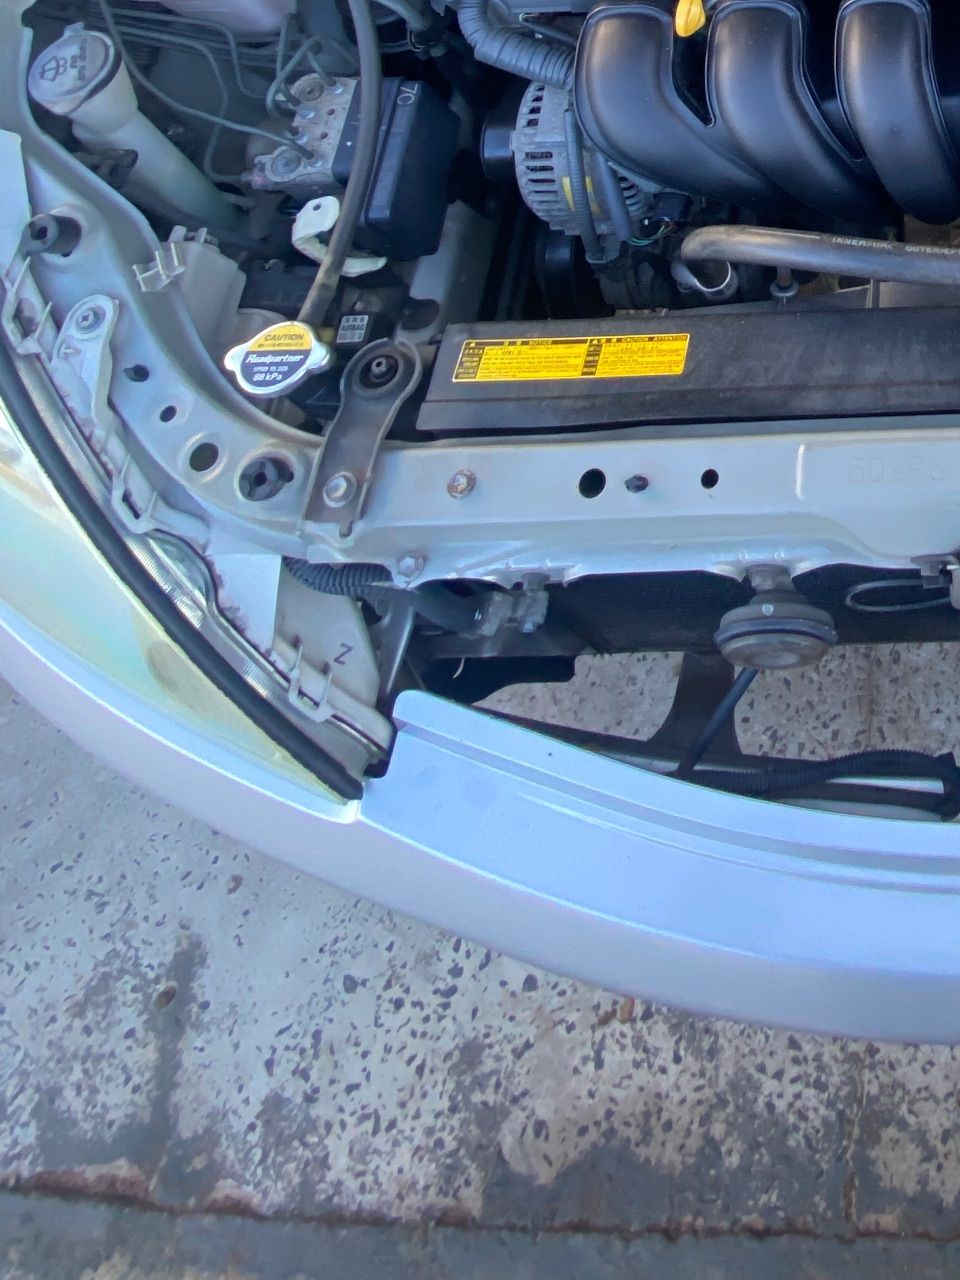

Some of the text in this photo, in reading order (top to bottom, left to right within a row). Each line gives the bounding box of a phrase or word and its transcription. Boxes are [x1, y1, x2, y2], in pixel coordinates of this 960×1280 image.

[341, 323, 365, 332] AIRBAG
[264, 333, 304, 342] CAUTION
[265, 372, 282, 381] kPa
